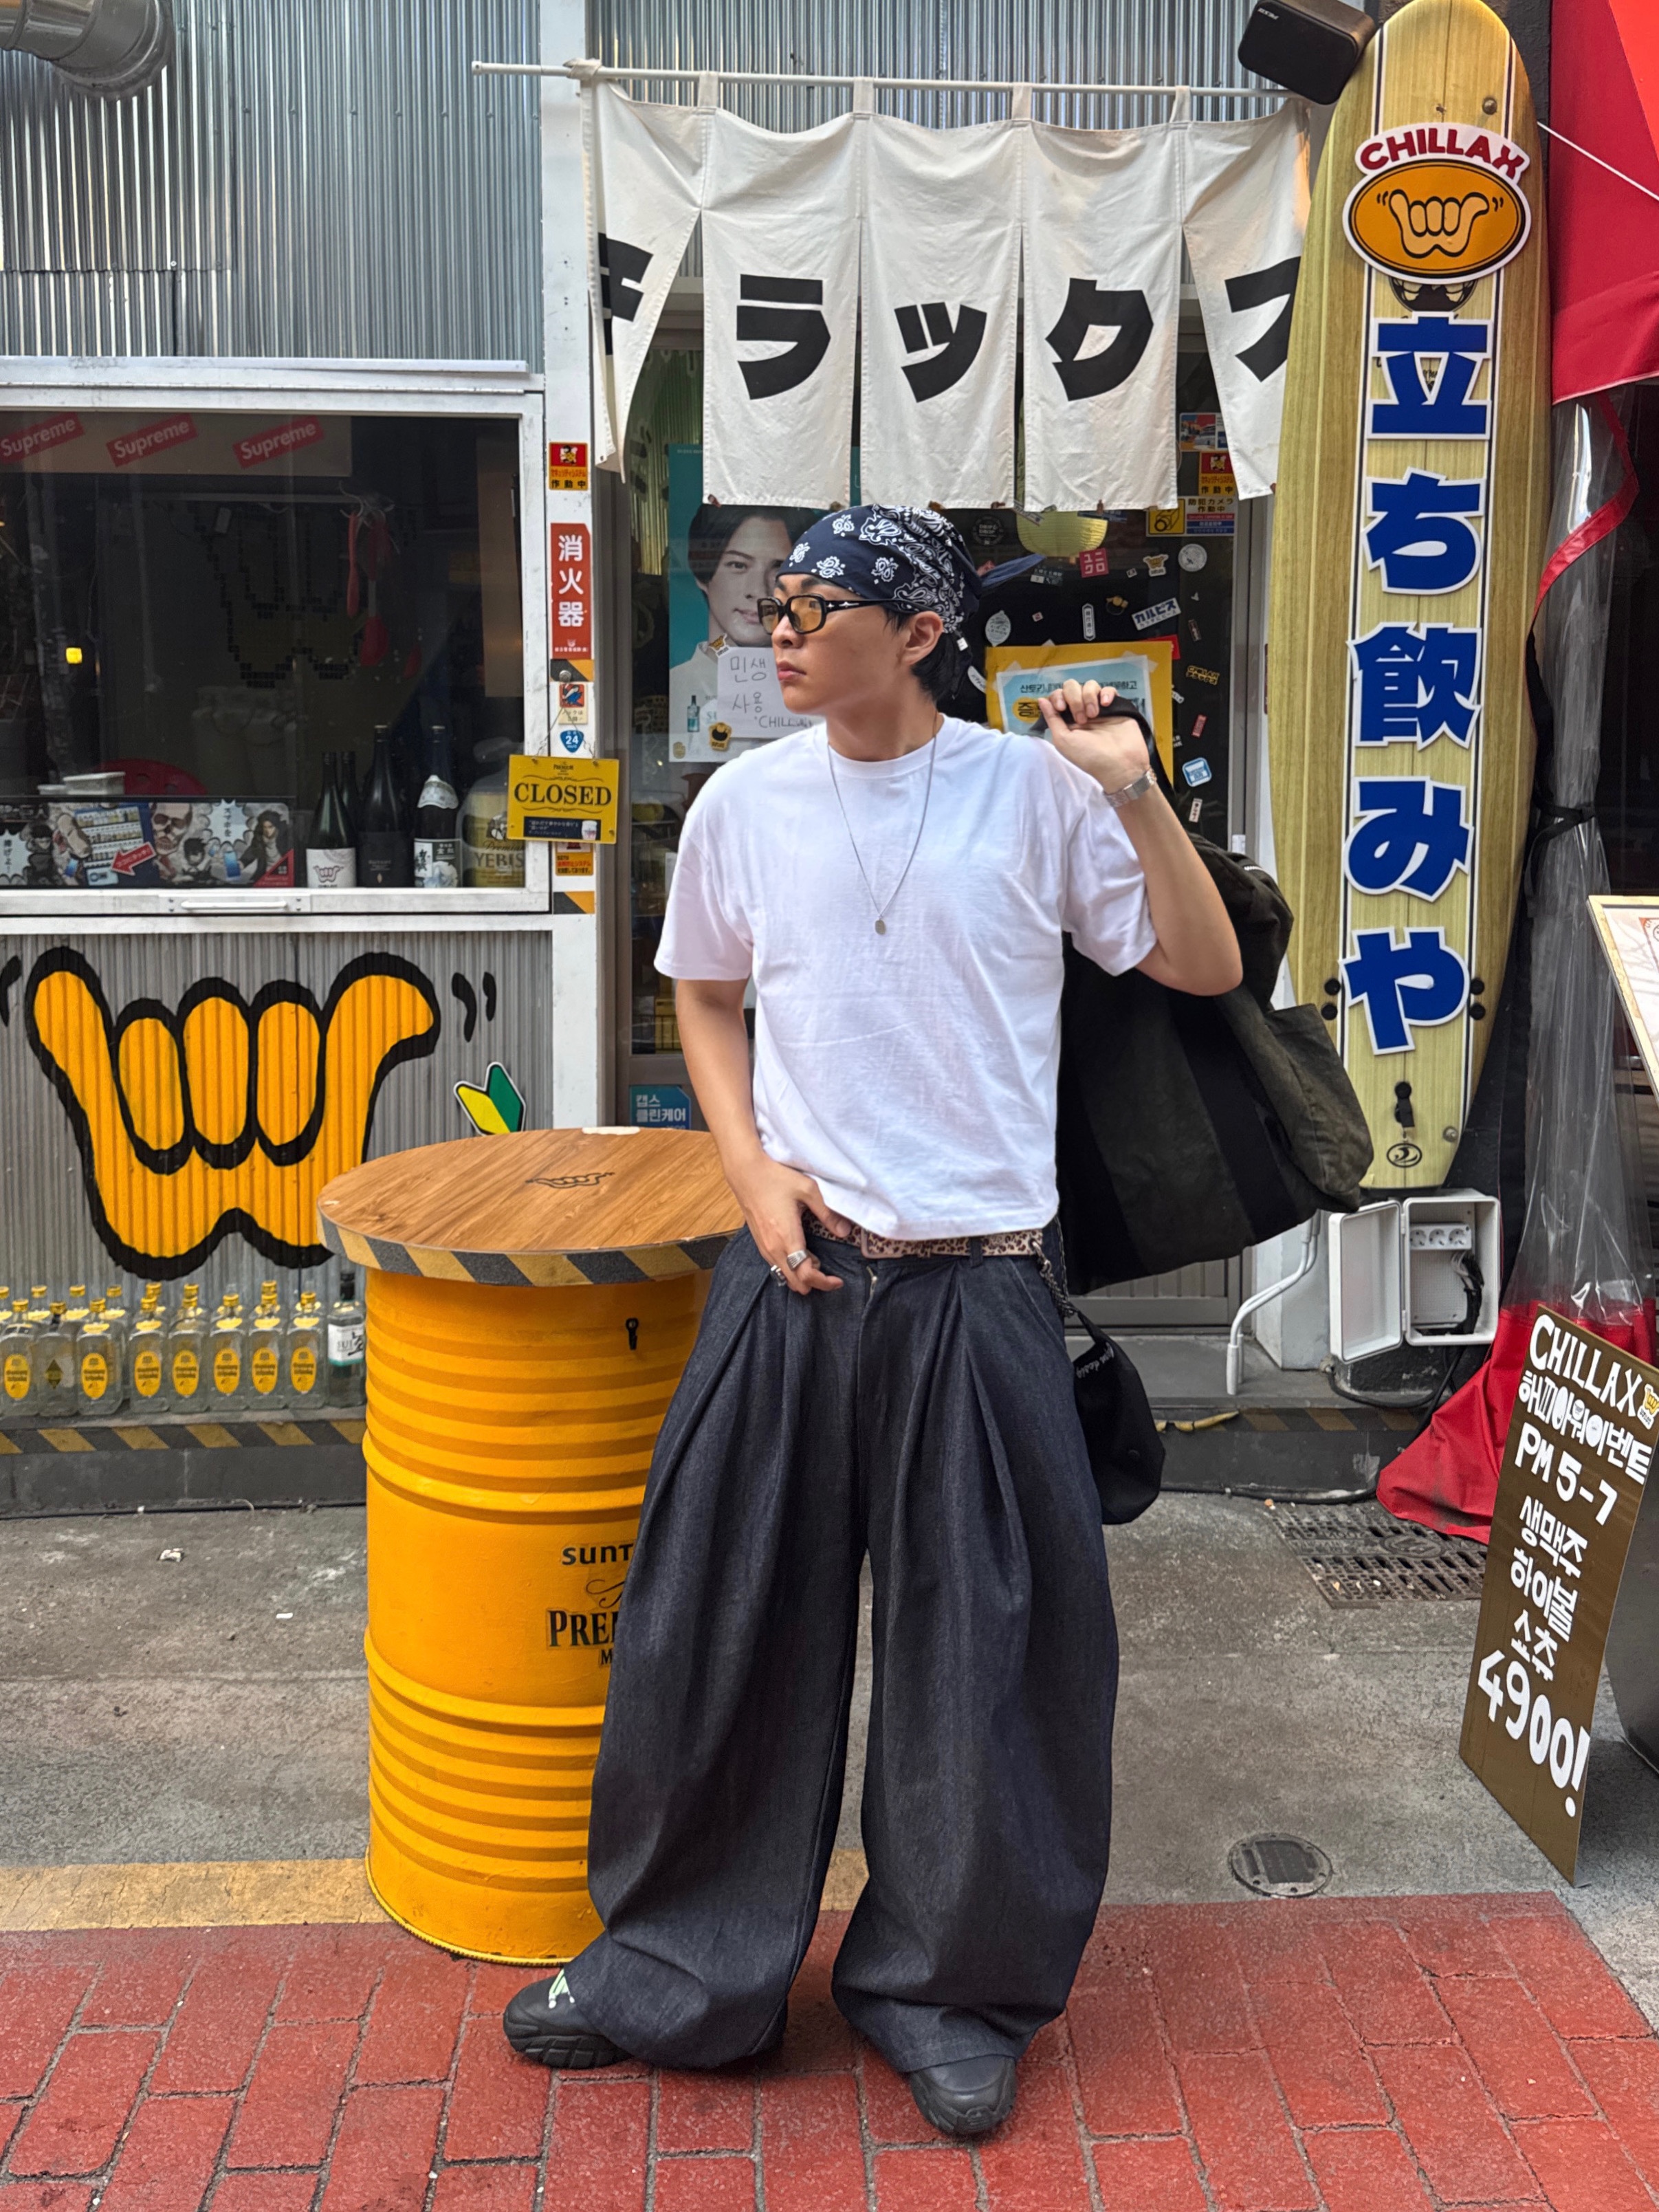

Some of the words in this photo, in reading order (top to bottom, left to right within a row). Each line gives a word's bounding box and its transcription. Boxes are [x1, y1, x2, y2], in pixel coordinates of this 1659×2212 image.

[1359, 128, 1525, 179] CHILLAX
[0, 418, 76, 457] Supreme
[113, 419, 190, 459] Supreme
[240, 421, 316, 461] Supreme
[551, 479, 586, 489] 作動中
[558, 534, 584, 627] 消火器
[1134, 600, 1177, 624] カルピス
[729, 655, 767, 683] 민생
[1341, 313, 1492, 1053] 立ち飲みや
[732, 692, 762, 714] 사용
[565, 735, 579, 745] 24
[514, 782, 612, 807] CLOSED
[636, 1094, 661, 1108] 캡스
[1529, 1313, 1642, 1418] CHILLAX
[1514, 1421, 1555, 1484] PM
[1555, 1451, 1619, 1526] 5-7
[1519, 1495, 1588, 1579] 생맥주
[1510, 1546, 1579, 1643] 하이볼
[1477, 1649, 1591, 1817] 4900!
